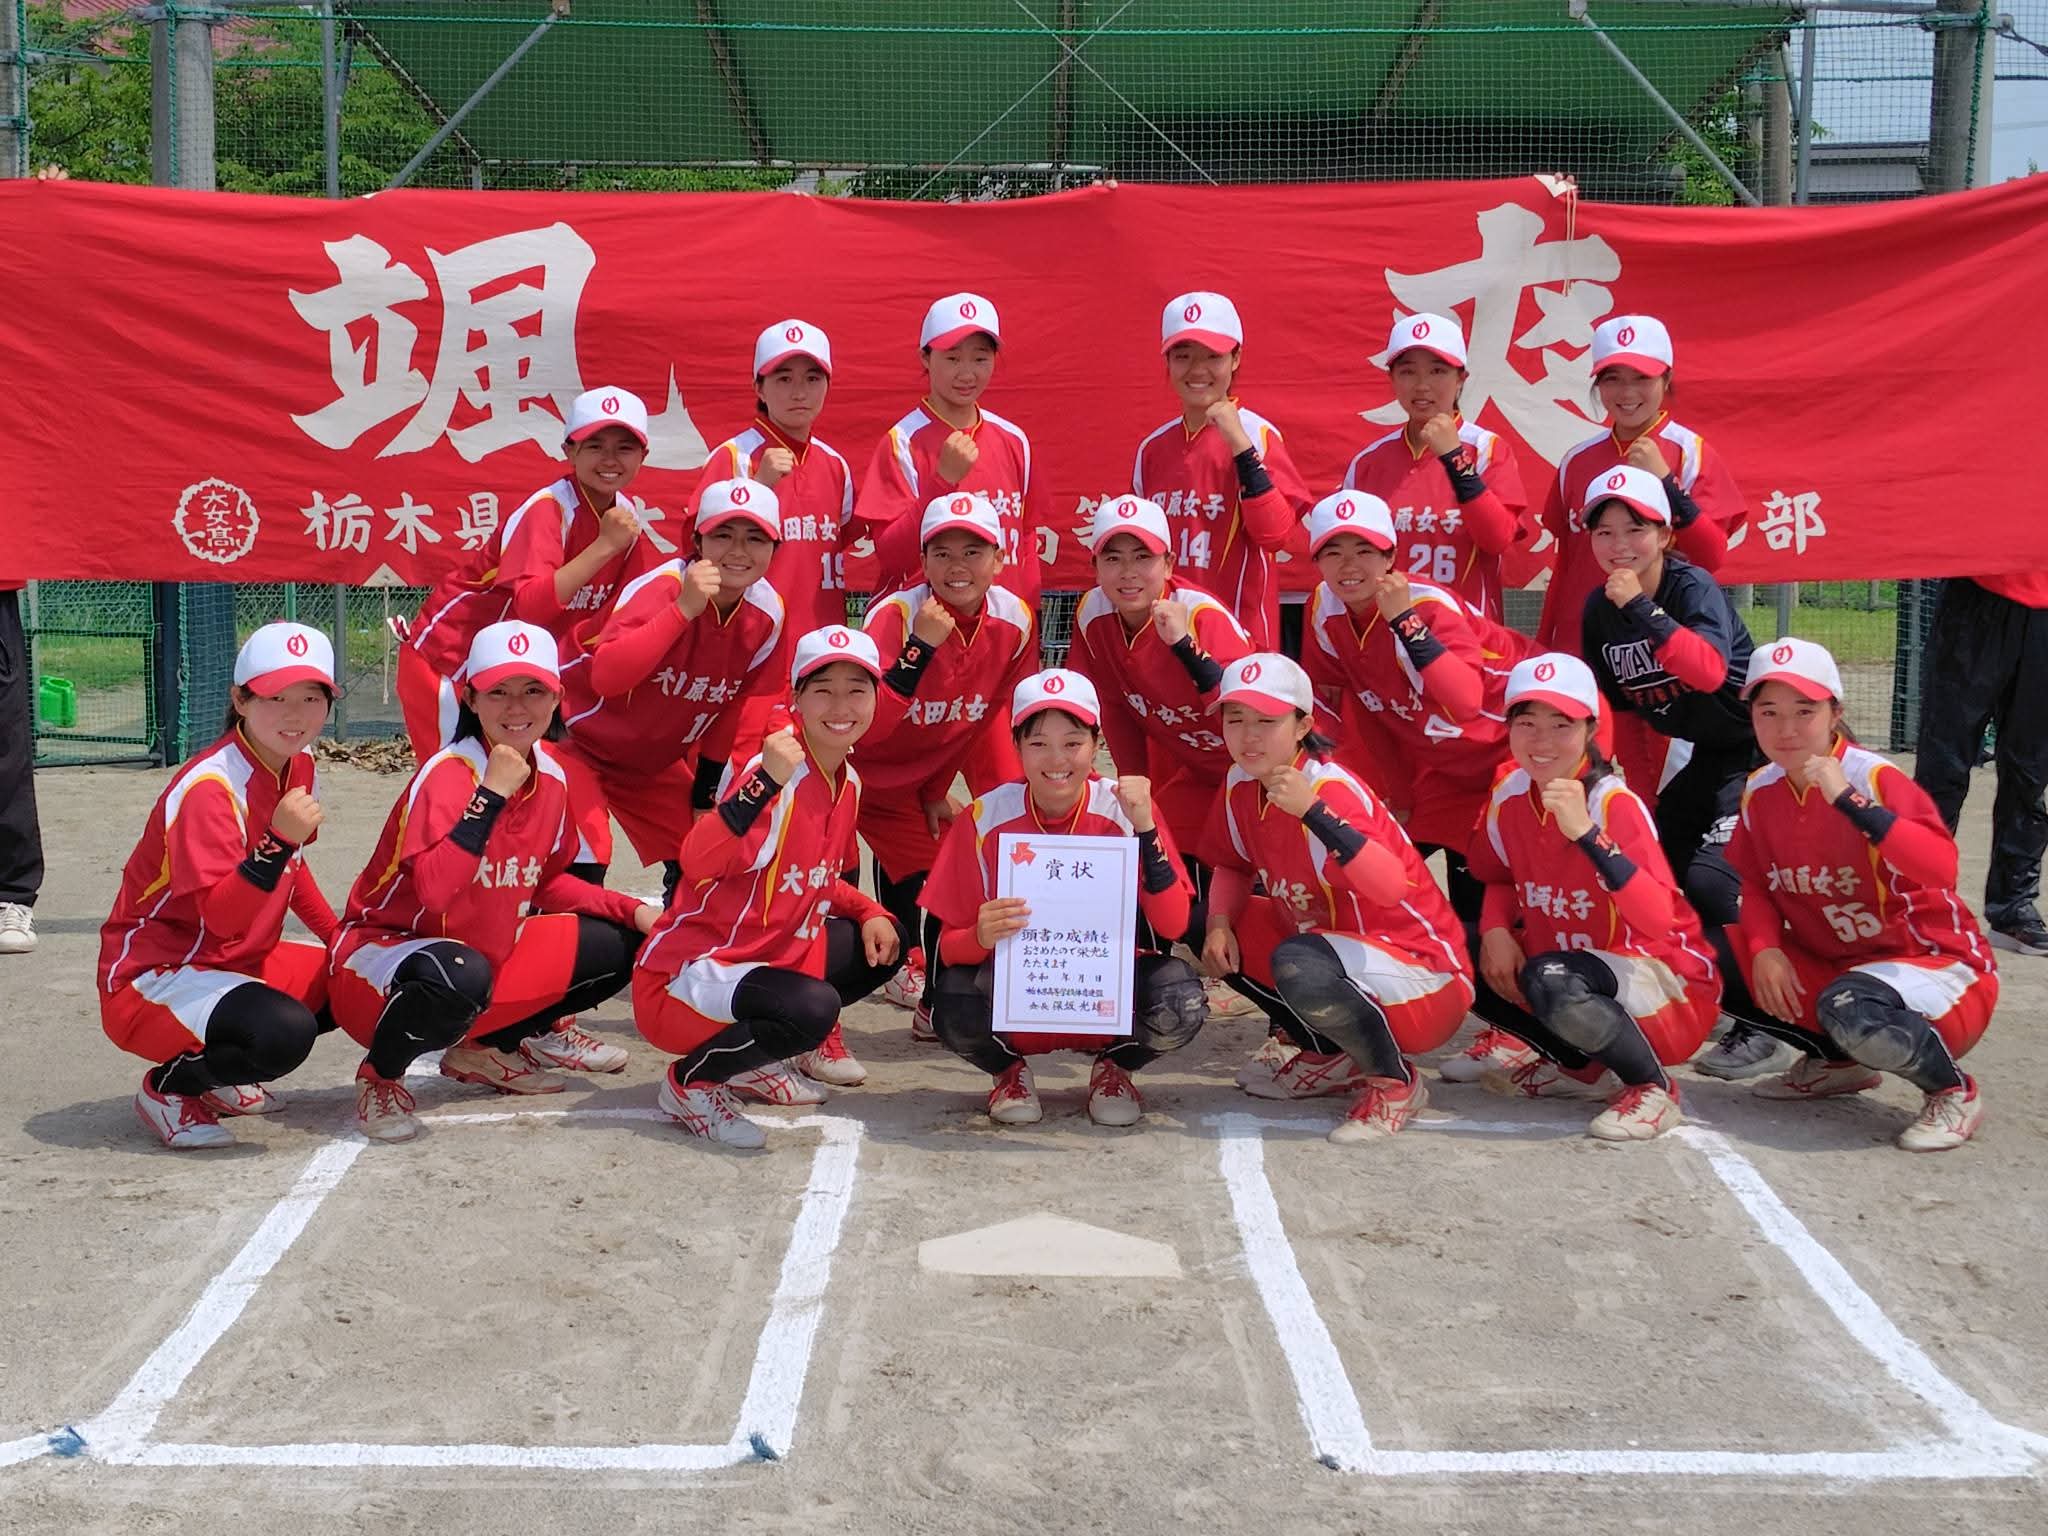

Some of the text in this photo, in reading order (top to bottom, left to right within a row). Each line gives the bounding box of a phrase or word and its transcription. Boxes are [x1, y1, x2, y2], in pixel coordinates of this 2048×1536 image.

[289, 221, 708, 472] 颯
[783, 513, 841, 542] 田原女
[1757, 490, 1827, 556] 部
[1178, 527, 1212, 570] 14
[1408, 543, 1457, 584] 26
[1045, 858, 1095, 881] 賞状
[1822, 902, 1883, 944] 55
